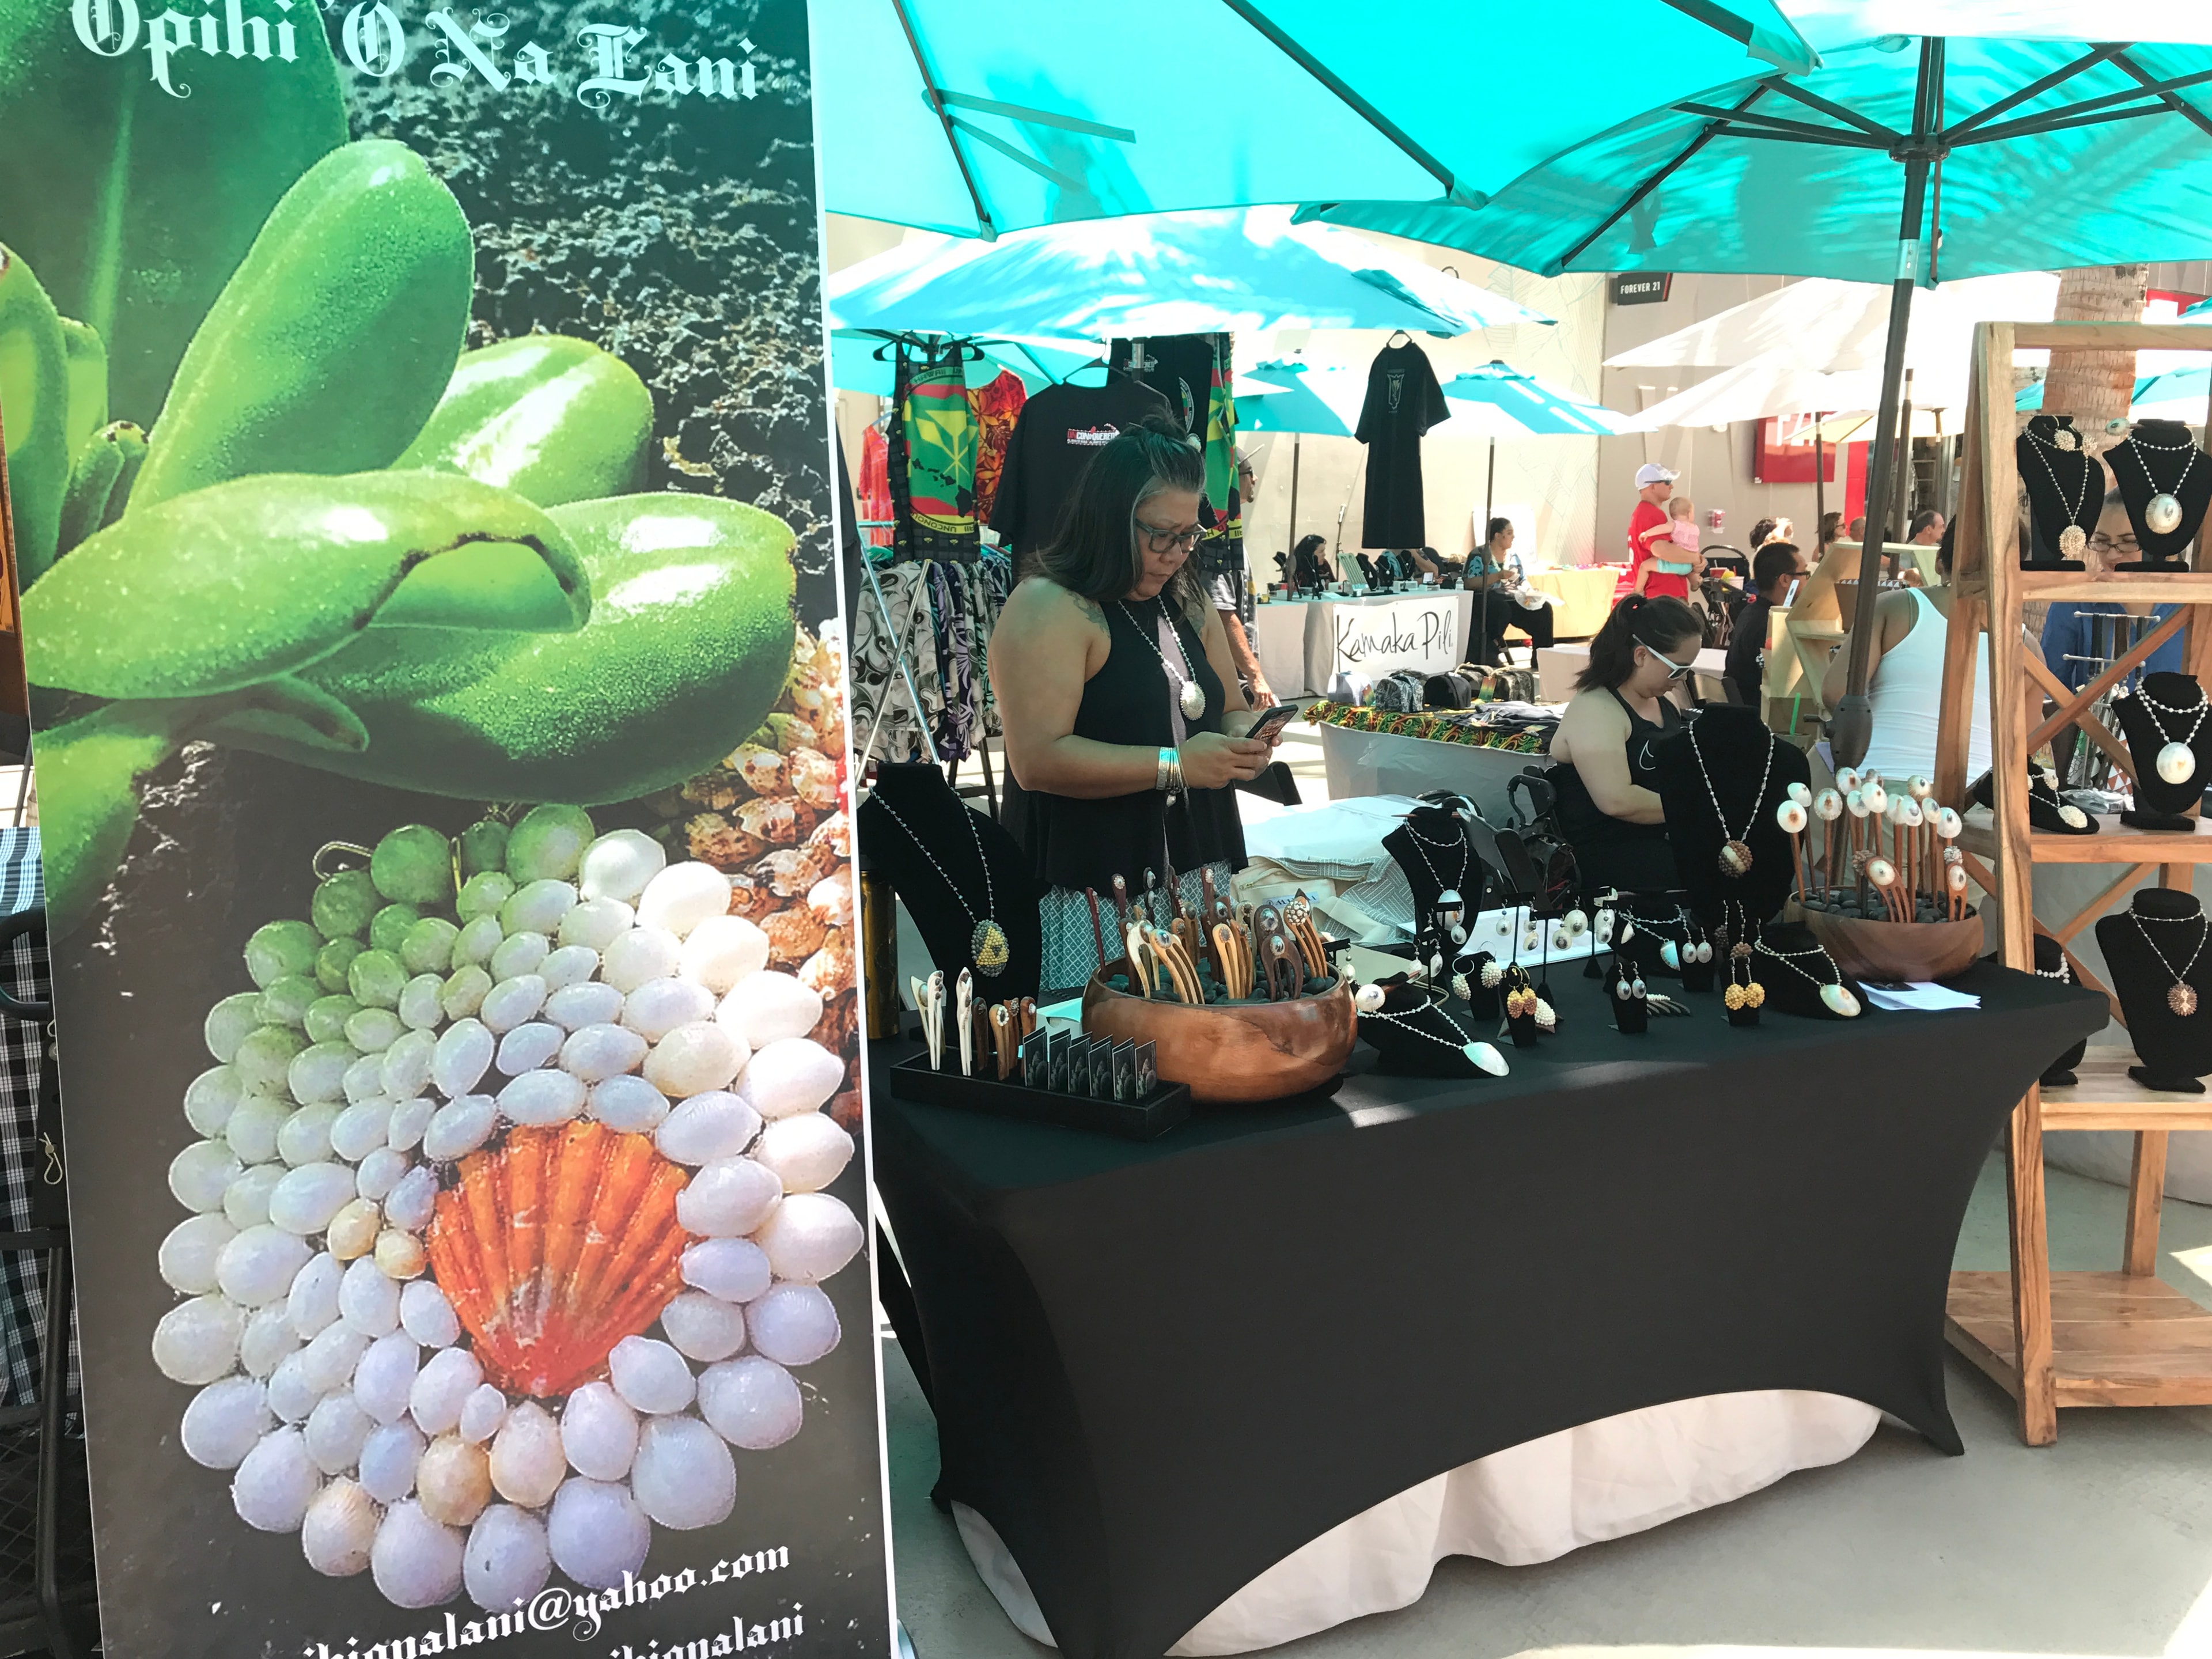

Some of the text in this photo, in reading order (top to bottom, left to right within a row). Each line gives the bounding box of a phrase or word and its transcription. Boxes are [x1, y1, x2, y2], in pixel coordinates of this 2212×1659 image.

[72, 0, 300, 99] Opihi
[425, 7, 558, 92] Na
[577, 23, 759, 109] Lani
[1620, 281, 1661, 294] FOREVER 21
[1336, 610, 1452, 673] Kamaka Pili
[302, 1546, 790, 1659] ionalani@yahoo.com
[608, 1602, 804, 1659] ionalani
